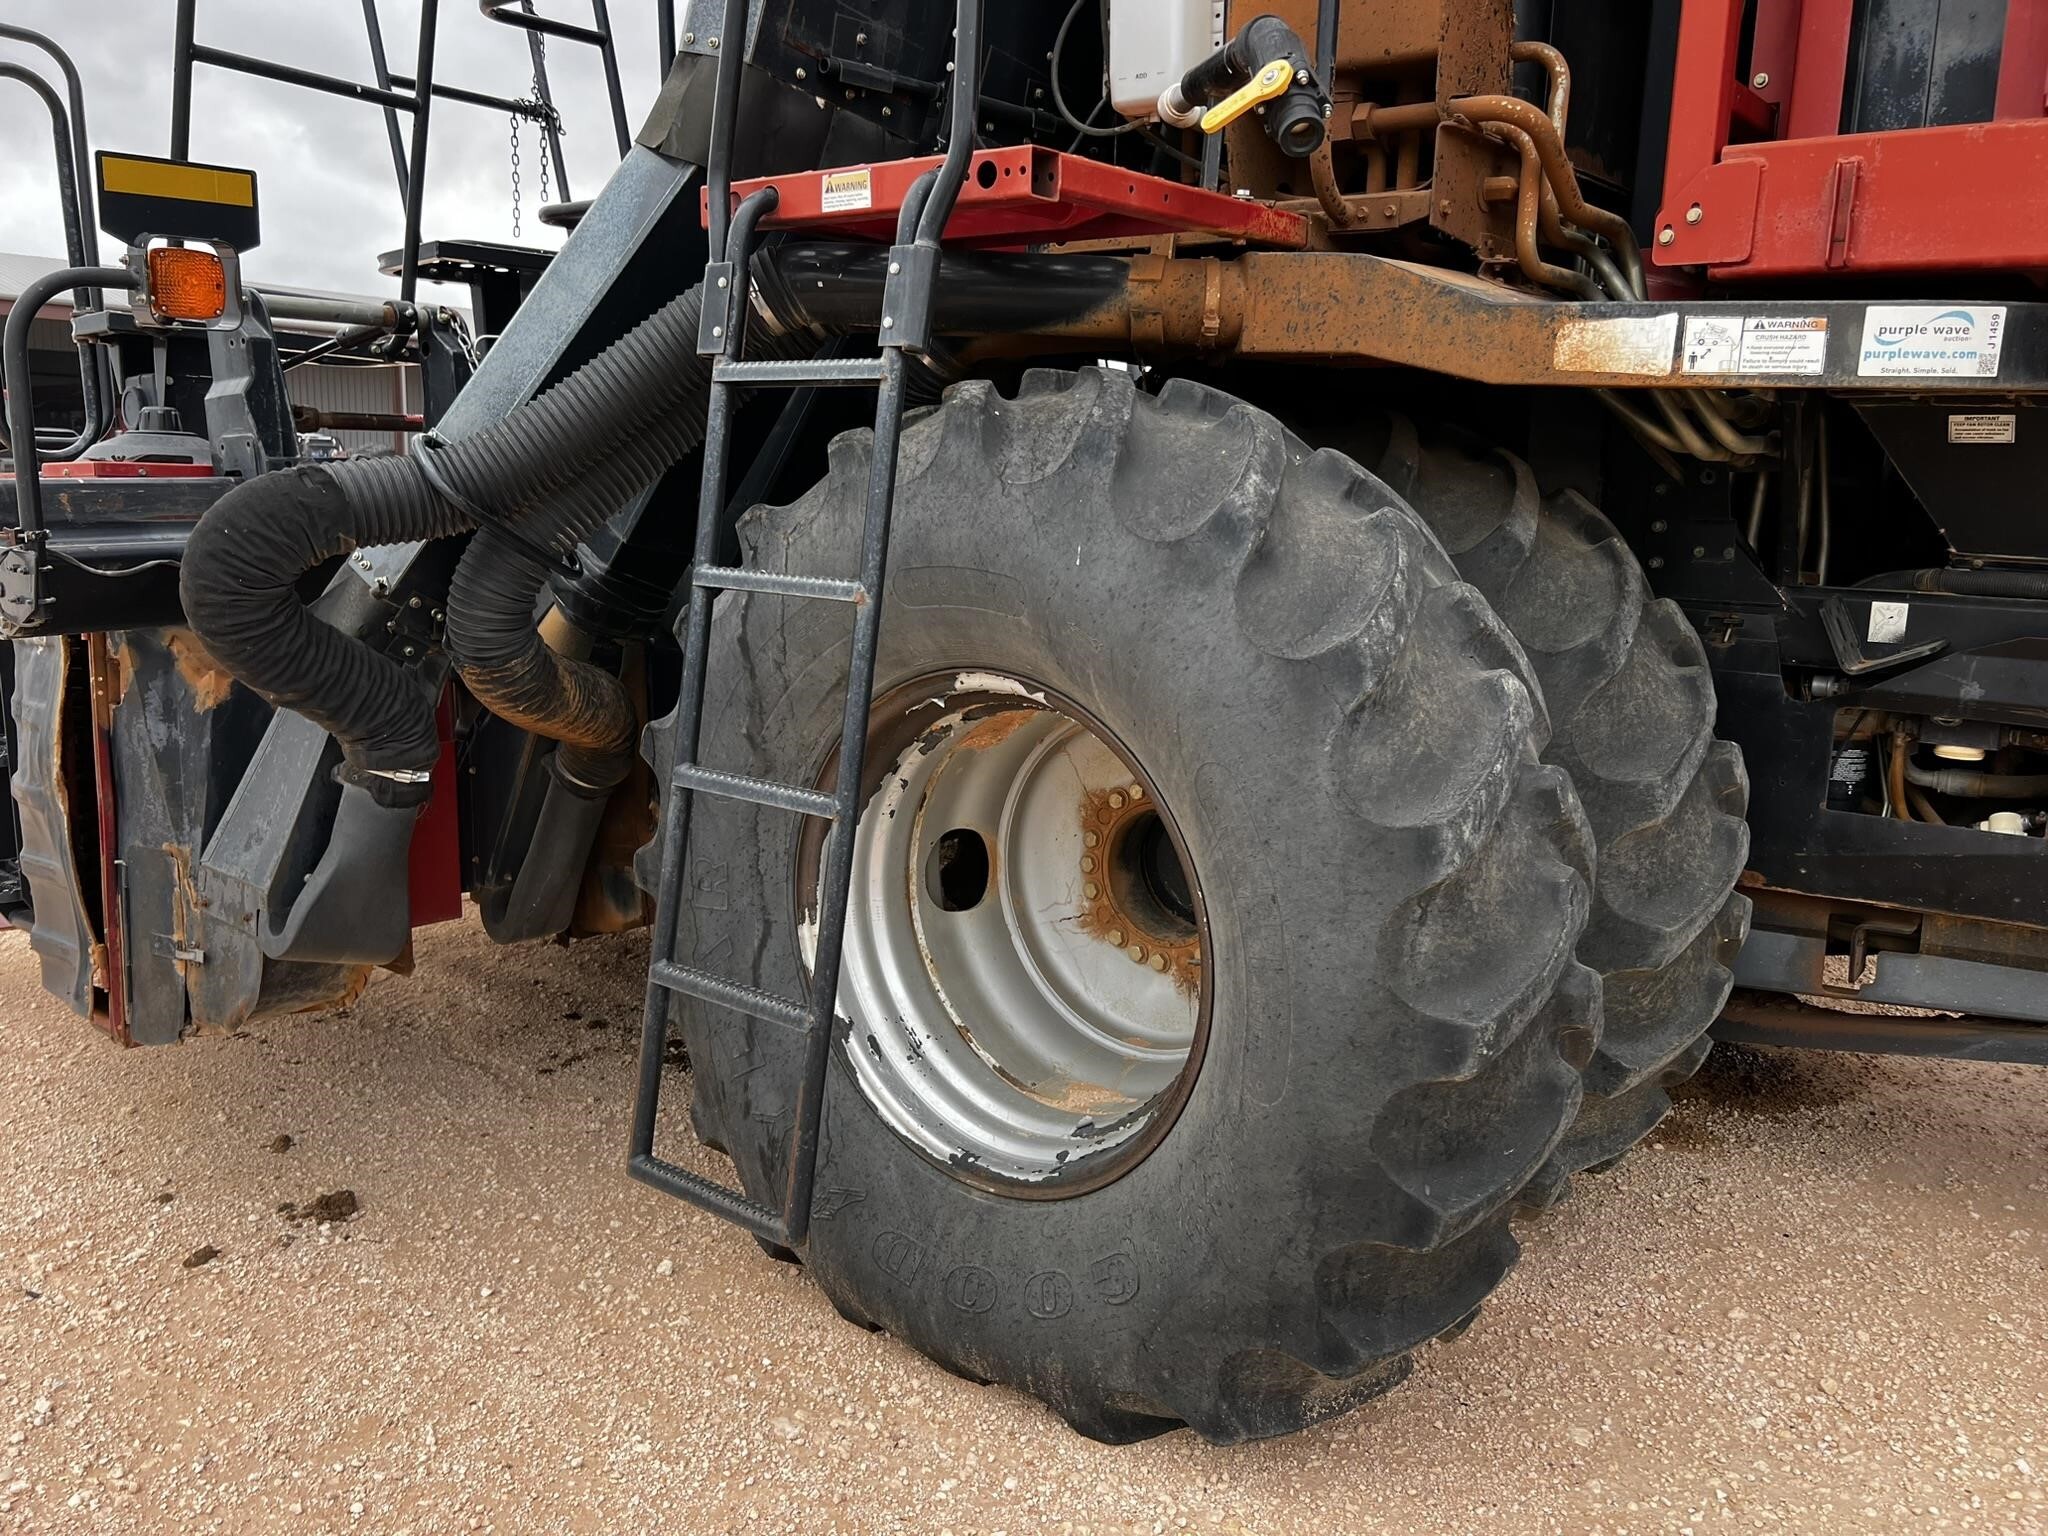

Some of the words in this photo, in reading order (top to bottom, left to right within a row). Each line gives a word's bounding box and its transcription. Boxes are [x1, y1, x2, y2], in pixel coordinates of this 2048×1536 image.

[834, 180, 867, 192] WARNING
[1767, 320, 1819, 329] WARNING
[1878, 324, 1928, 337] purple
[1933, 326, 1970, 335] wave
[1988, 313, 2000, 339] 1459
[1863, 348, 1977, 361] purplewave.com
[1880, 367, 1911, 375] Straight.
[1913, 367, 1939, 375] Simple.
